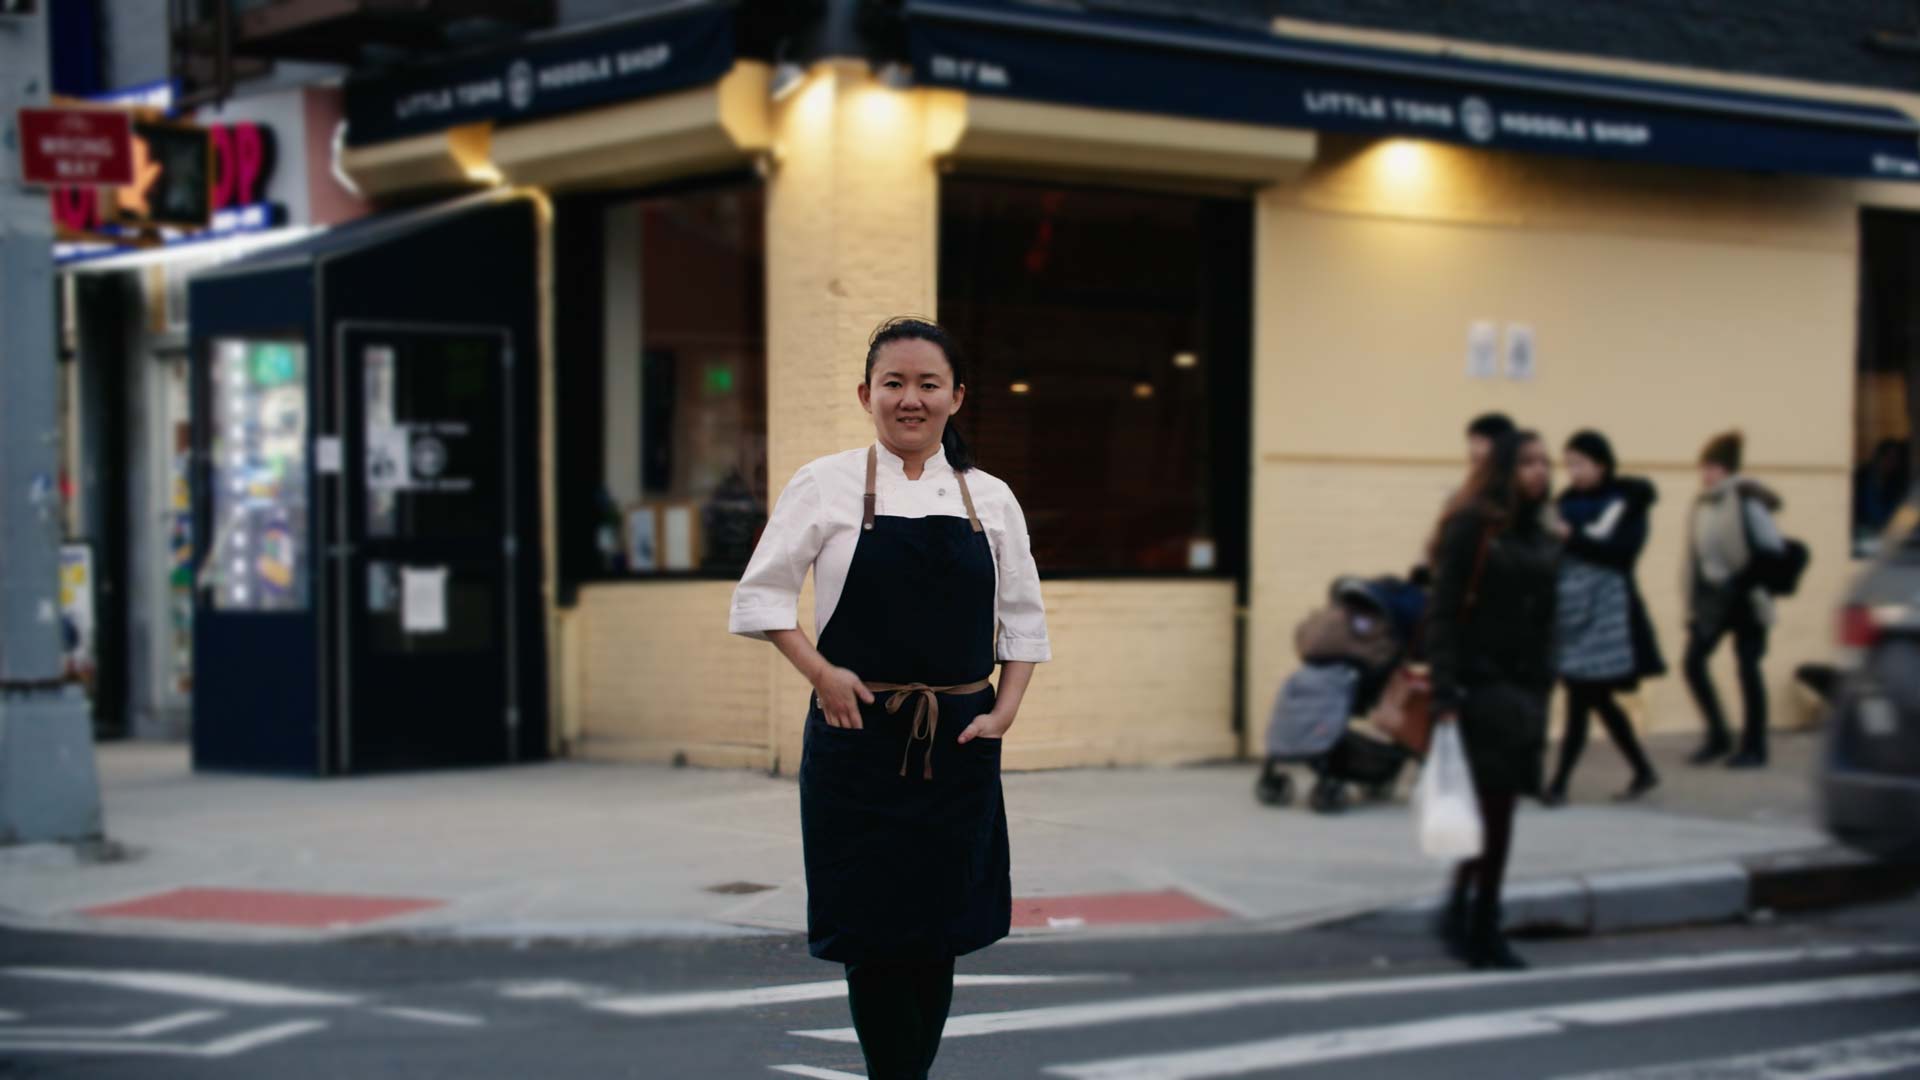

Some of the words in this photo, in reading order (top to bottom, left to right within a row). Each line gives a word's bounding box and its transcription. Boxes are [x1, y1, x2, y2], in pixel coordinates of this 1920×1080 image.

[617, 43, 670, 74] SHOP
[1304, 92, 1384, 119] LITTLE
[1501, 113, 1587, 140] NOODLE
[1592, 121, 1649, 144] SHOP
[41, 137, 113, 157] WRONG
[57, 159, 99, 177] WAY
